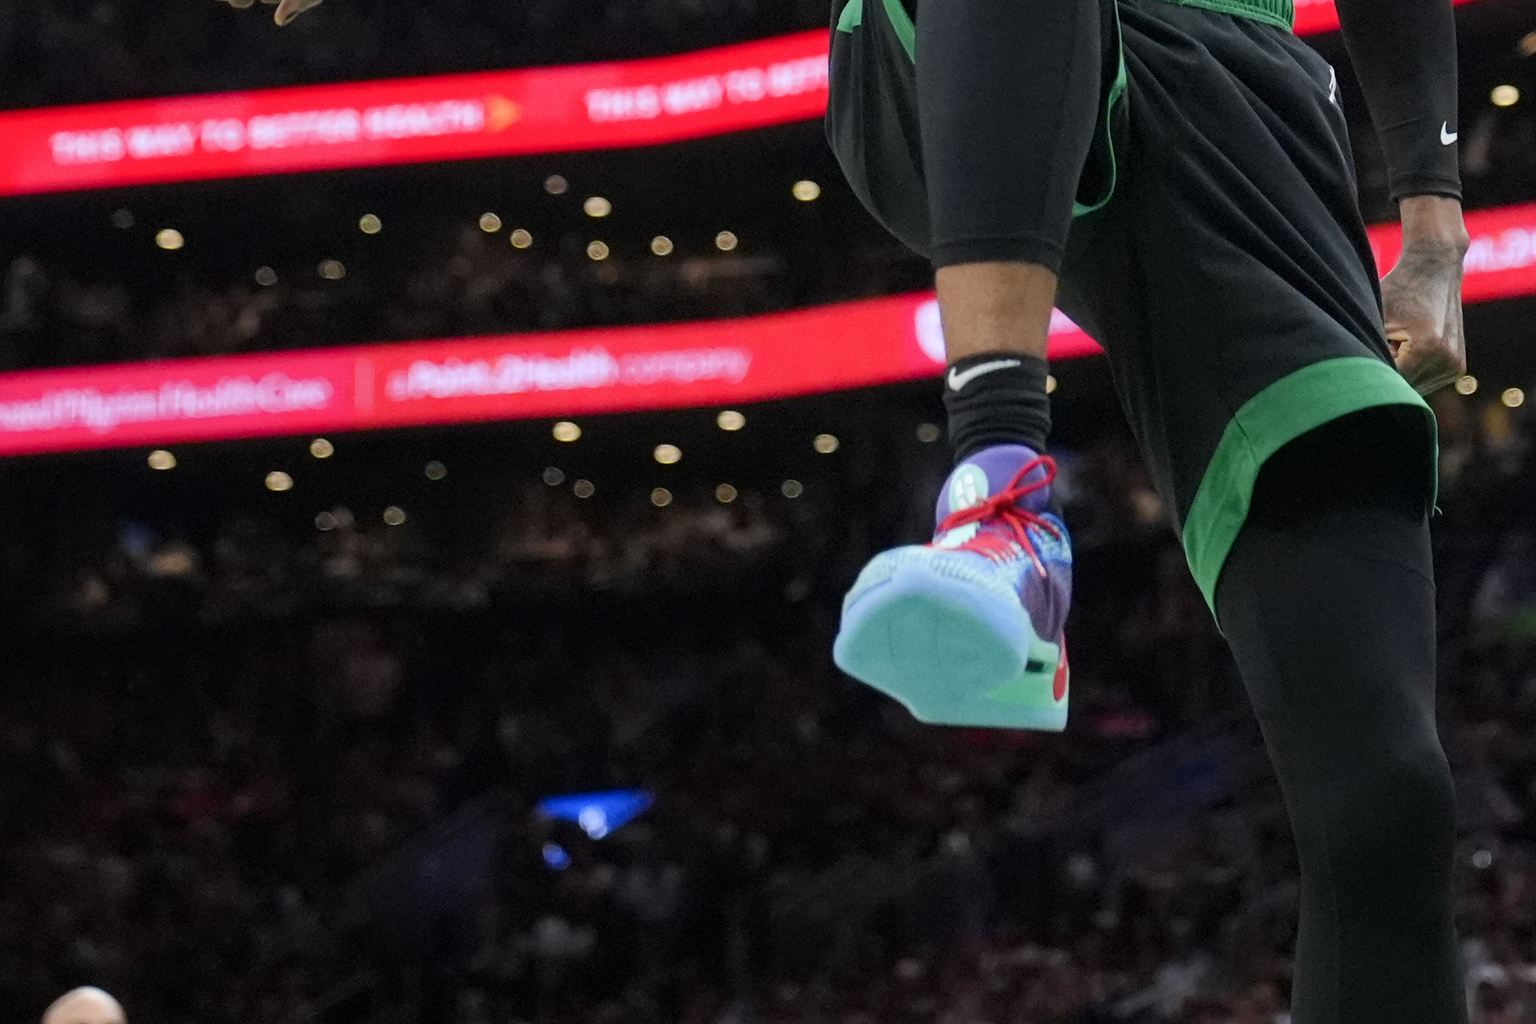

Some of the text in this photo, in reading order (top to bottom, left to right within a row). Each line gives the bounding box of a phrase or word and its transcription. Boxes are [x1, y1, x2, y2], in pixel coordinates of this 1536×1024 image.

[586, 85, 660, 123] THIS
[661, 75, 723, 115] WAY
[725, 66, 766, 104] TO
[51, 127, 125, 165] THIS
[126, 121, 197, 159] WAY
[200, 118, 245, 153] TO
[247, 107, 361, 149] BETTER
